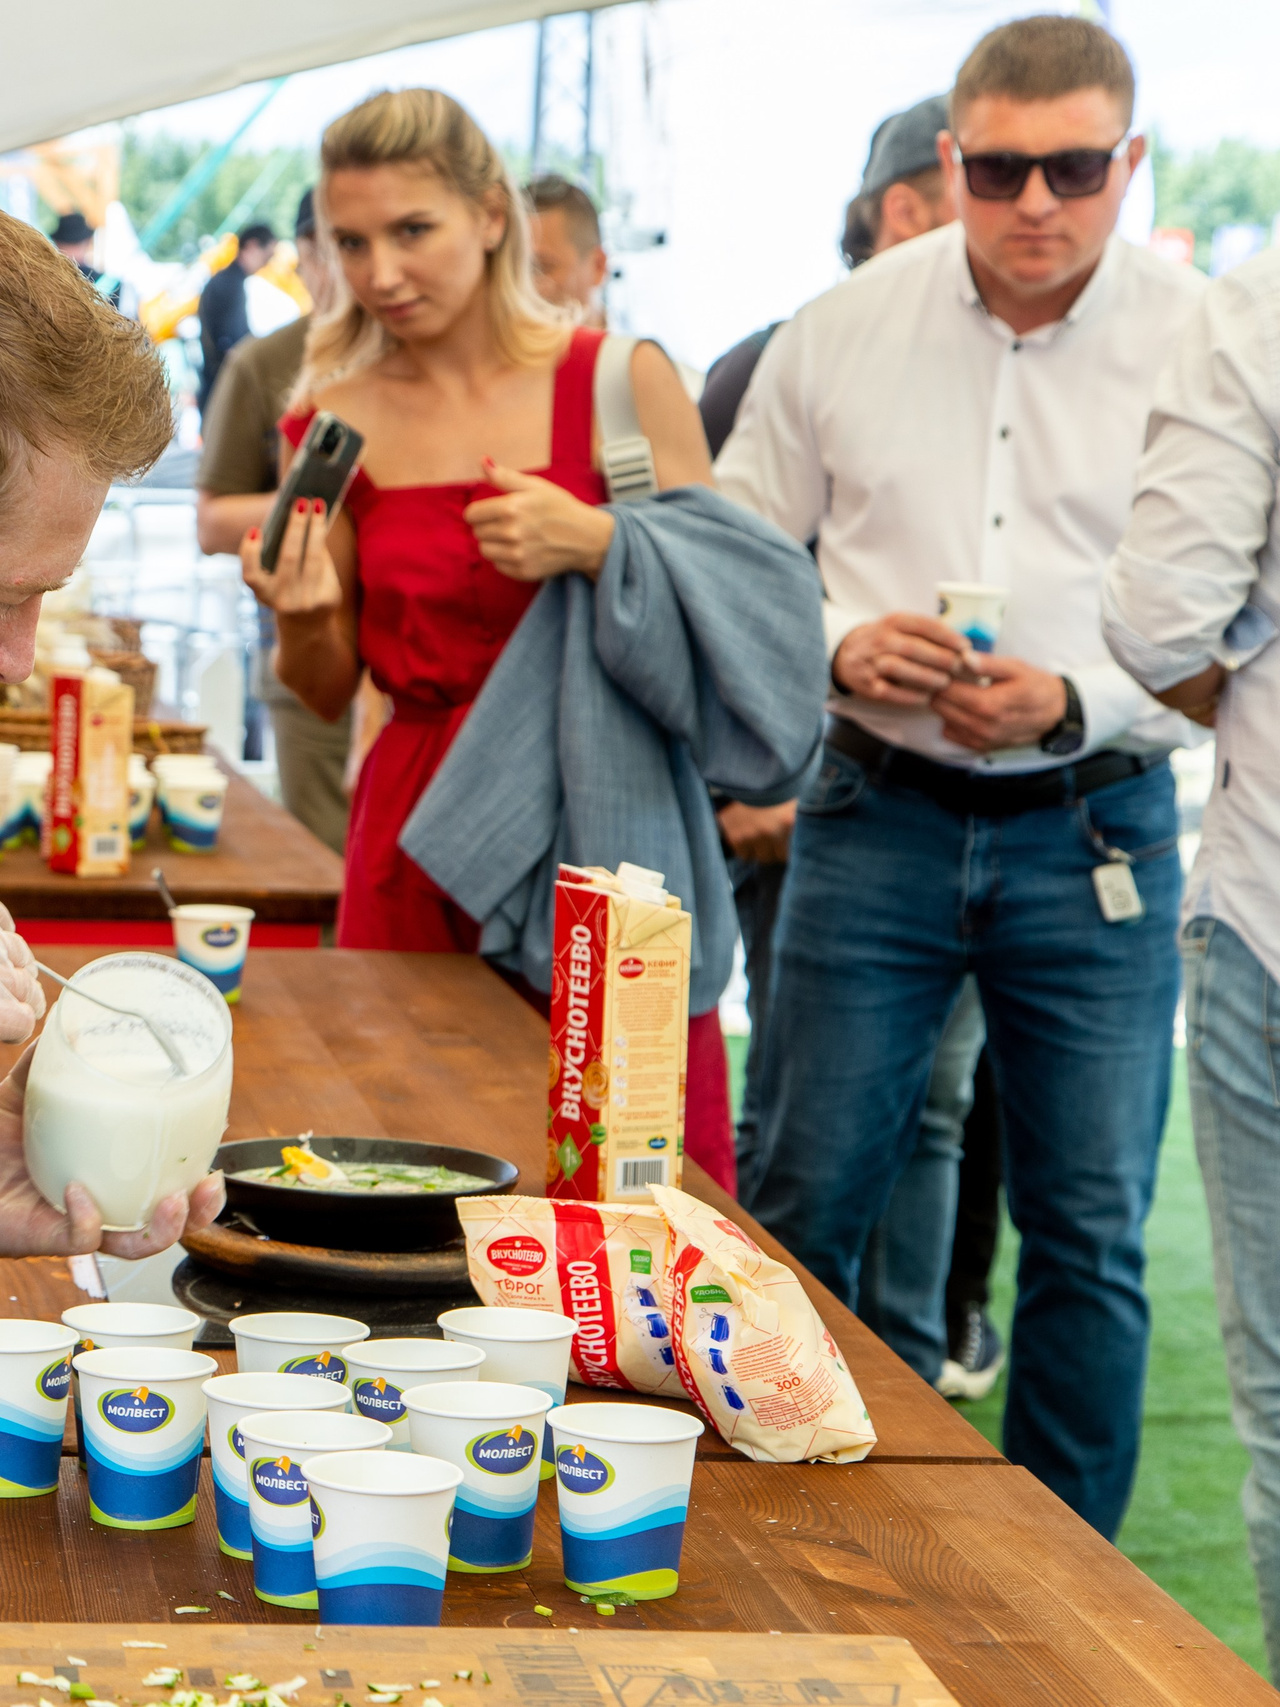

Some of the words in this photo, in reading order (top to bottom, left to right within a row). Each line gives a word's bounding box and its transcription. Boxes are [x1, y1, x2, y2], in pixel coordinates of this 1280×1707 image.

[647, 960, 677, 968] КЕФИР
[560, 923, 592, 1122] ВКУСНОТЕЕВО
[491, 1249, 543, 1263] ВКУСНОТЕЕВО
[694, 1288, 727, 1296] УДОБНО
[763, 1374, 788, 1384] МАССА
[356, 1393, 402, 1411] МОЛВЕСТ
[107, 1404, 166, 1418] МОЛВЕСТ
[776, 1421, 796, 1431] ГОСТ
[478, 1445, 533, 1459] МОЛВЕСТ
[558, 1461, 604, 1480] МОЛВЕСТ
[255, 1474, 309, 1491] МОЛВЕСТ
